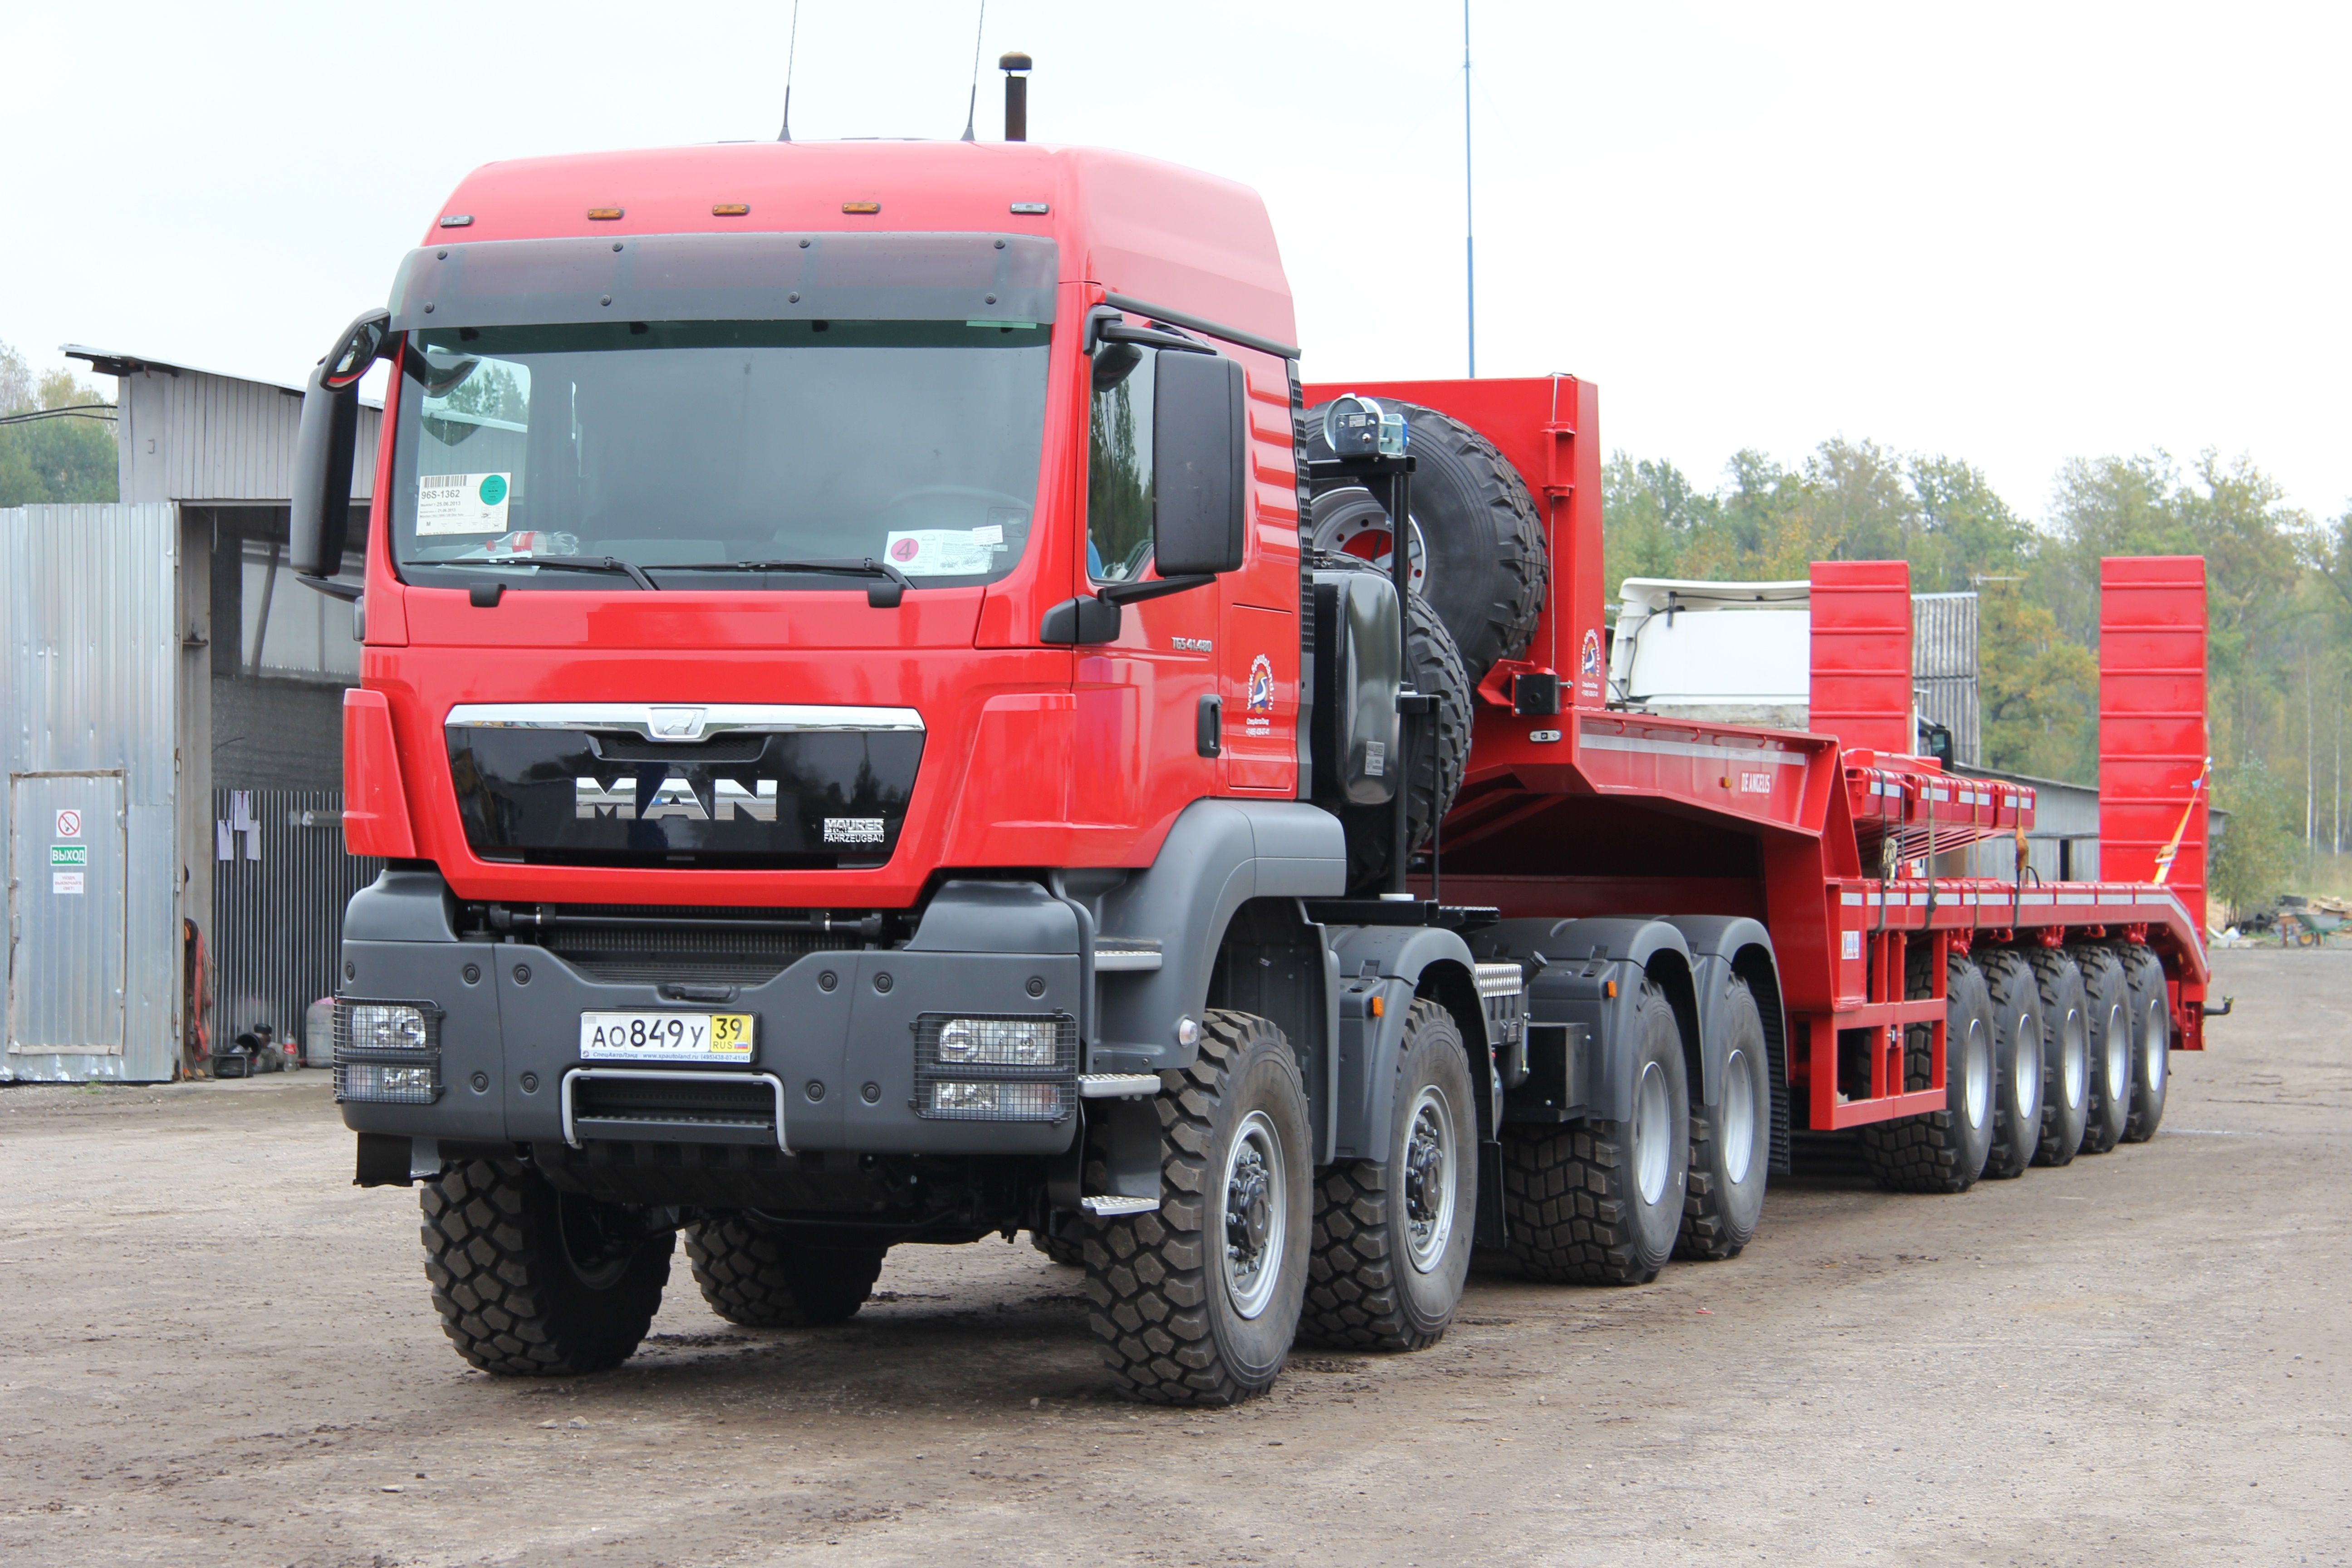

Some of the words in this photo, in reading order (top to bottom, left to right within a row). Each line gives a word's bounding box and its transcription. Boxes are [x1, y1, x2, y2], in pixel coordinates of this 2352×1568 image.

[421, 490, 460, 500] 96S-1362
[896, 540, 911, 559] 4
[1187, 638, 1212, 652] 41.480
[1741, 773, 1749, 792] DE
[576, 777, 778, 821] MAN
[824, 819, 884, 830] MAURER
[824, 833, 884, 843] FAHRZEUGBAU
[52, 850, 84, 862] ВЫХОД
[715, 1018, 743, 1040] 39
[712, 1041, 733, 1049] RUS
